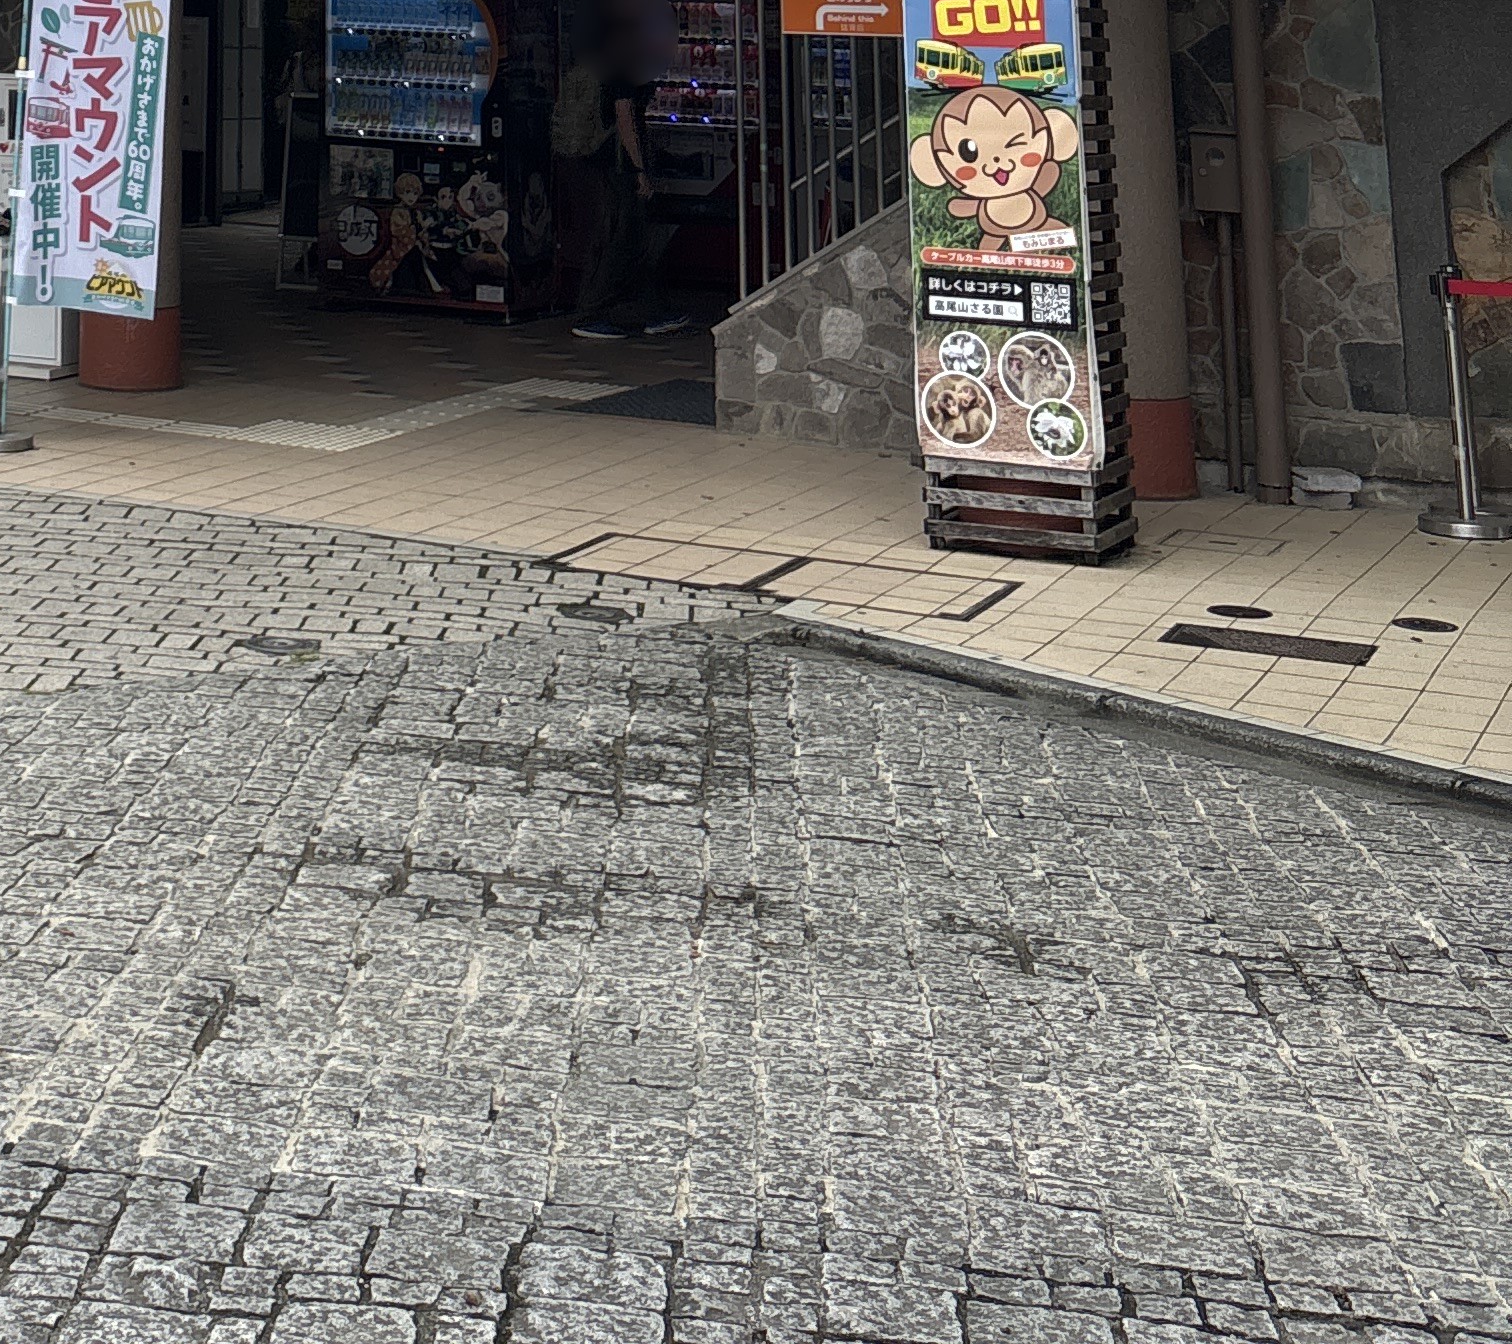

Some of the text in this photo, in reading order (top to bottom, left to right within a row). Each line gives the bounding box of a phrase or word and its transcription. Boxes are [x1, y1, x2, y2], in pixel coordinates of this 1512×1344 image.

[935, 300, 1004, 317] 高尾山さる園
